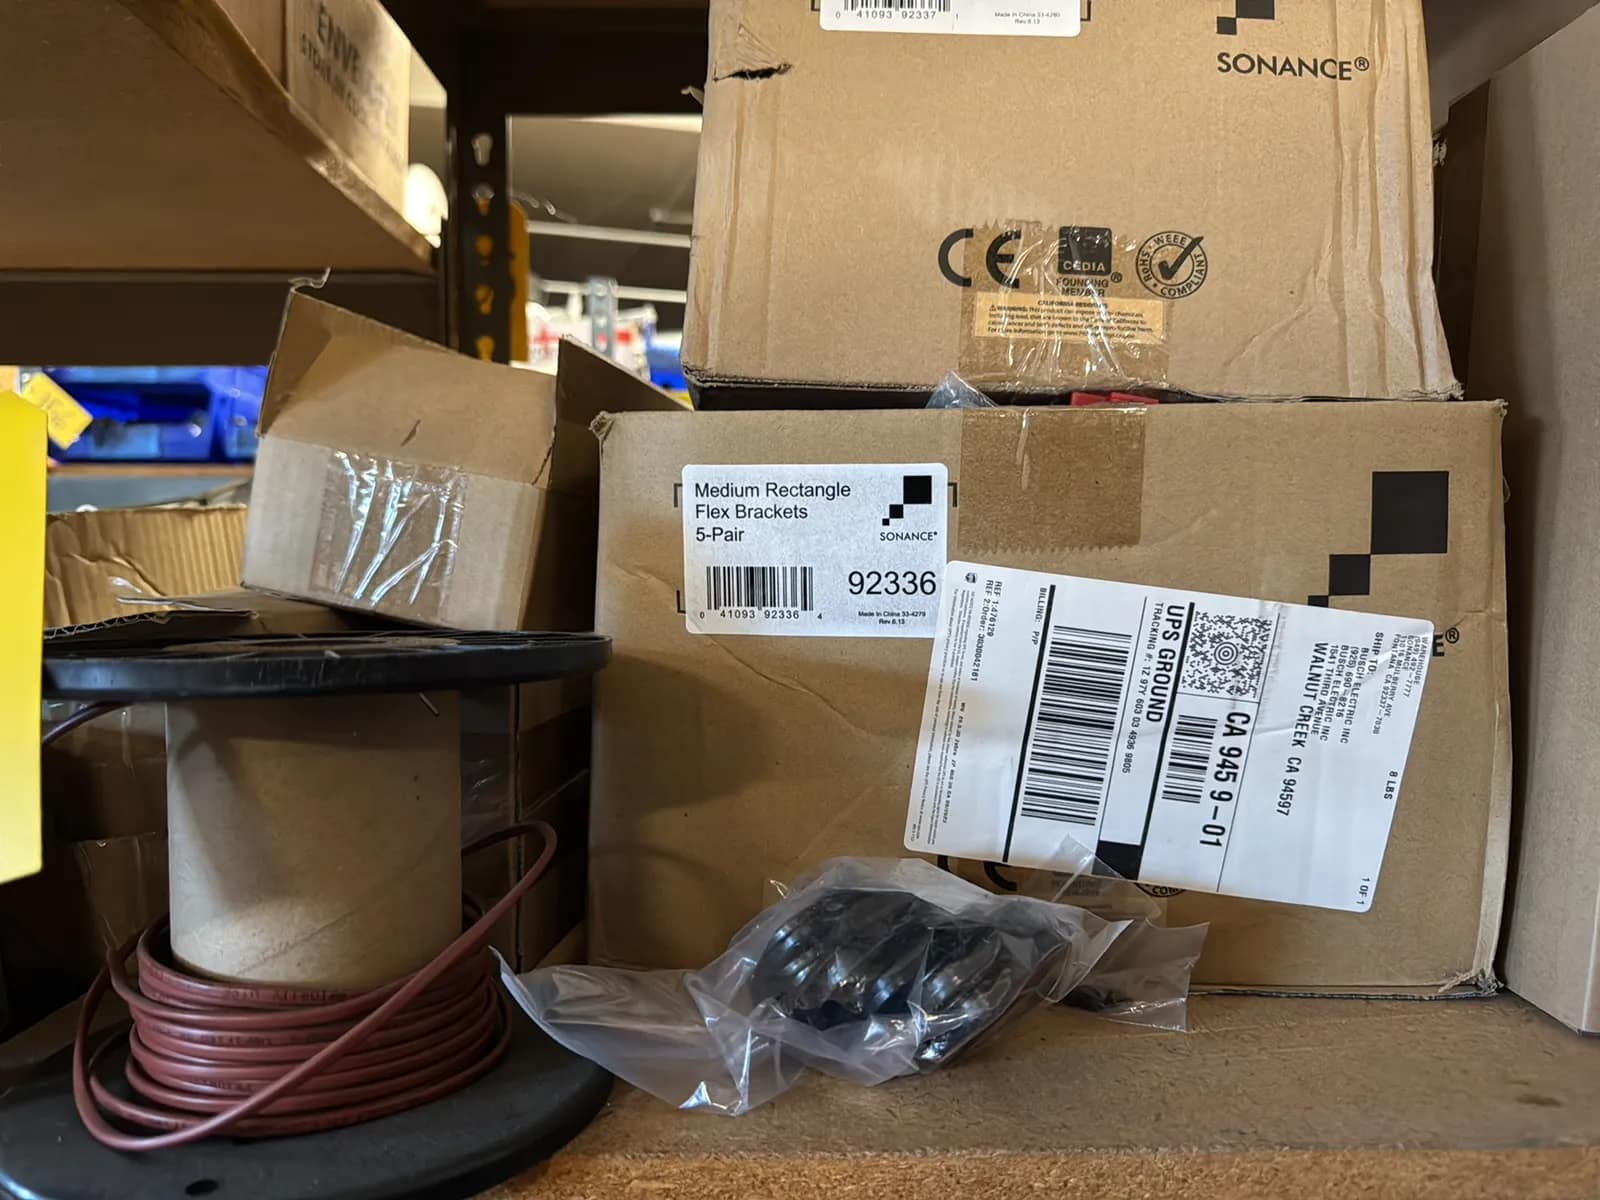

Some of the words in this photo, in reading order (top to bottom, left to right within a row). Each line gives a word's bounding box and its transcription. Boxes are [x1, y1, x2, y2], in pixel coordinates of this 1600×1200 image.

[856, 10, 893, 19] 41093
[901, 10, 937, 20] 92337
[1153, 234, 1187, 246] WEEE
[1063, 260, 1106, 272] CEDIA
[1160, 253, 1205, 297] COMPLIANT
[695, 482, 760, 498] Medium
[766, 482, 851, 500] Rectangle
[695, 504, 730, 519] Flex
[735, 504, 808, 519] Brackets
[696, 527, 745, 542] 5-Pair
[848, 570, 937, 595] 92336
[983, 579, 993, 596] REF
[992, 580, 1002, 597] REF
[699, 611, 705, 619] 0
[720, 610, 755, 619] 41093
[764, 610, 800, 619] 92336
[1034, 587, 1047, 622] BILLING:
[1146, 602, 1164, 650] TRACKING
[1161, 604, 1184, 642] UPS
[1370, 631, 1383, 655] SHIP
[1326, 644, 1338, 665] 1541
[1334, 644, 1349, 676] BUSCH
[1345, 645, 1358, 668] (925)
[1354, 647, 1369, 679] BUSCH
[1301, 641, 1328, 701] WALNUT
[1319, 667, 1333, 696] THIRD
[1383, 673, 1392, 684] CA
[1136, 678, 1148, 695] 97Y
[1144, 647, 1176, 723] GROUND
[1133, 698, 1144, 714] 603
[1323, 679, 1340, 722] ELECTRIC
[1343, 682, 1361, 725] ELECTRIC
[1130, 716, 1140, 728] 03
[1221, 710, 1251, 739] CA
[1290, 704, 1314, 748] CREEK
[1310, 698, 1326, 735] AVENUE
[1126, 729, 1138, 750] 4936
[1319, 724, 1330, 741] INC
[1339, 727, 1351, 744] INC
[1121, 752, 1133, 774] 9805
[1212, 744, 1242, 783] 945
[1284, 756, 1302, 774] CA
[1275, 777, 1296, 816] 94597
[1382, 780, 1396, 800] LBS
[1357, 884, 1368, 897] OF
